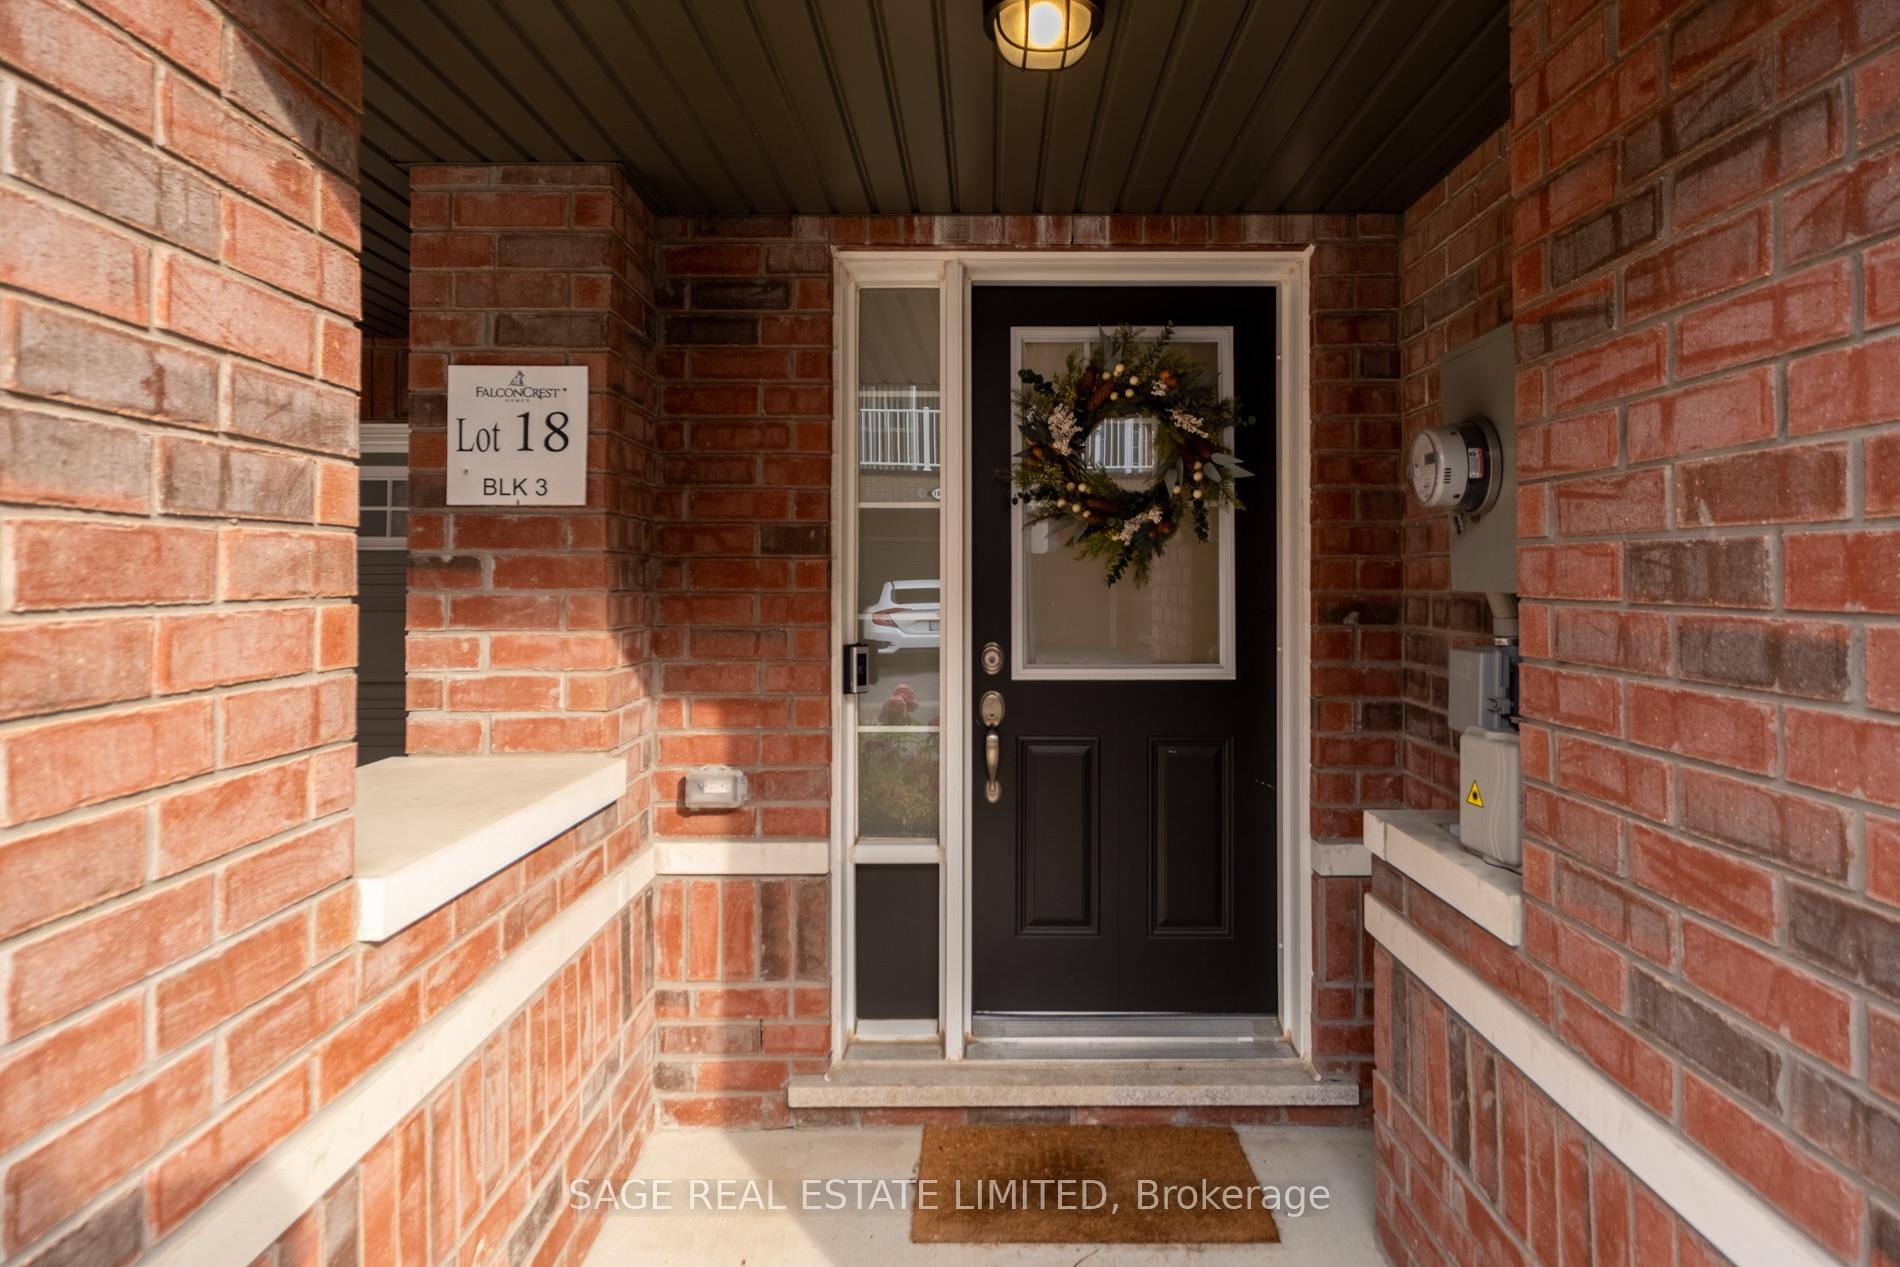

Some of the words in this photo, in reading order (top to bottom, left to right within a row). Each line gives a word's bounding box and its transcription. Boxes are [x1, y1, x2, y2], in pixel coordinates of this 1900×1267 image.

[476, 386, 560, 399] FALCONCREST
[456, 417, 501, 452] Lot
[516, 411, 569, 452] 18
[483, 478, 527, 496] BLK
[535, 478, 548, 496] 3
